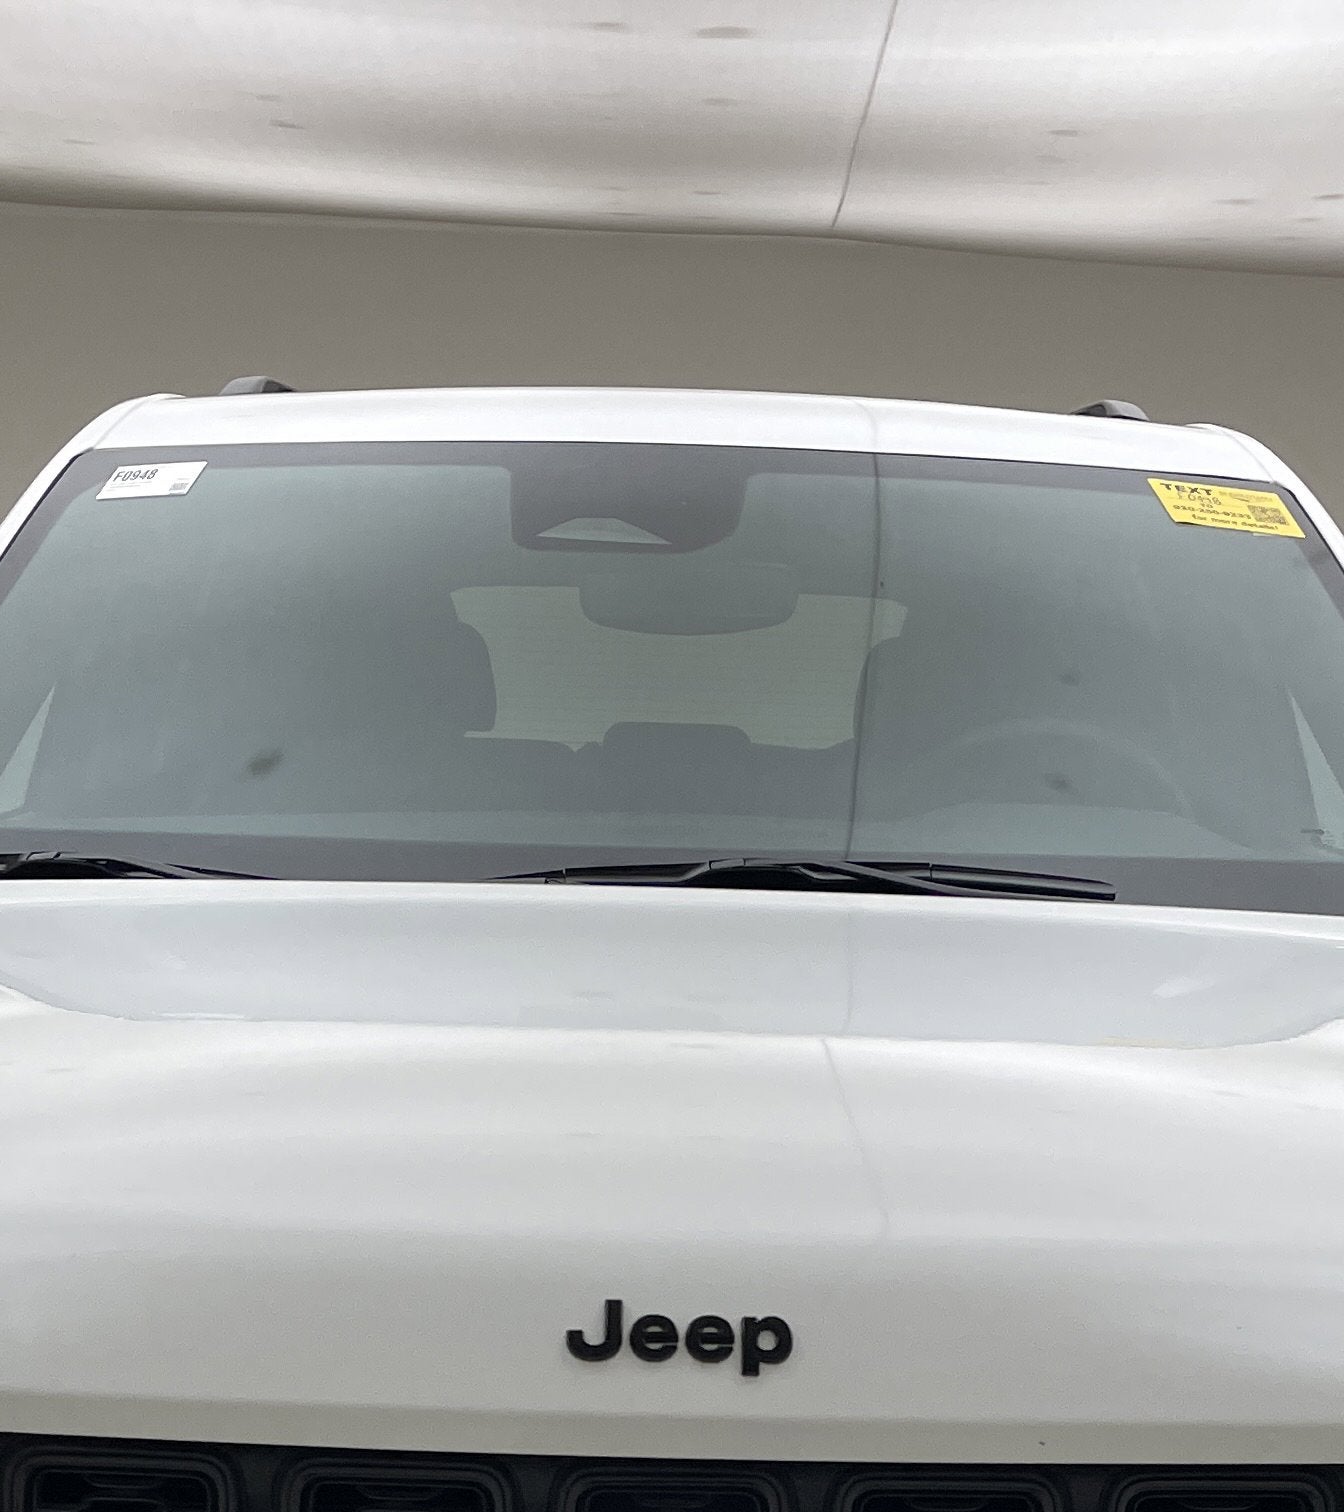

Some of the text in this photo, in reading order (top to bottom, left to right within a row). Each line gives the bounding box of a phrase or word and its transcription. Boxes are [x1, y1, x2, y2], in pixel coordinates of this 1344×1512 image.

[113, 468, 159, 482] F0948
[1159, 482, 1213, 496] TEXT
[566, 1299, 793, 1377] Jeep
